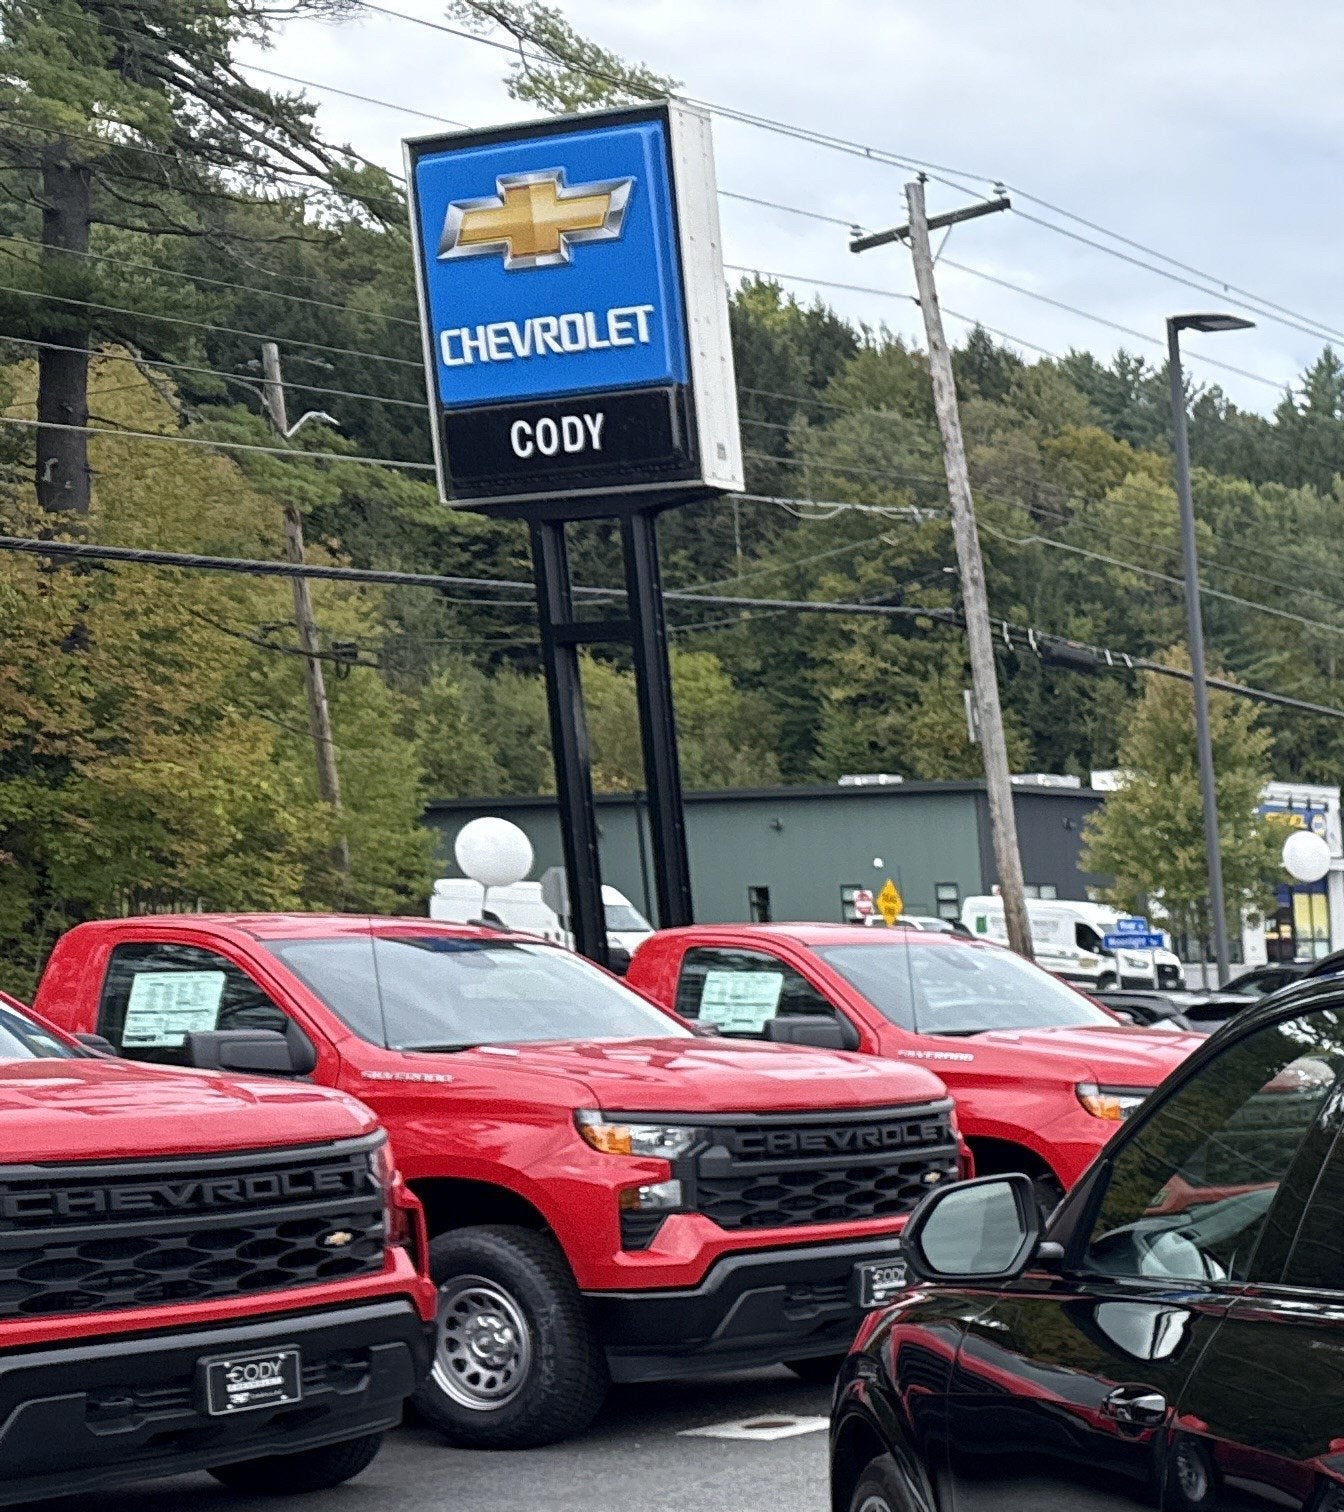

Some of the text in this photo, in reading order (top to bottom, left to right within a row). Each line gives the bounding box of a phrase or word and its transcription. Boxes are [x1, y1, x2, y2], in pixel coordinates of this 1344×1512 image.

[440, 304, 655, 367] CHEVROLET
[510, 412, 604, 458] CODY
[226, 1360, 282, 1383] CODY
